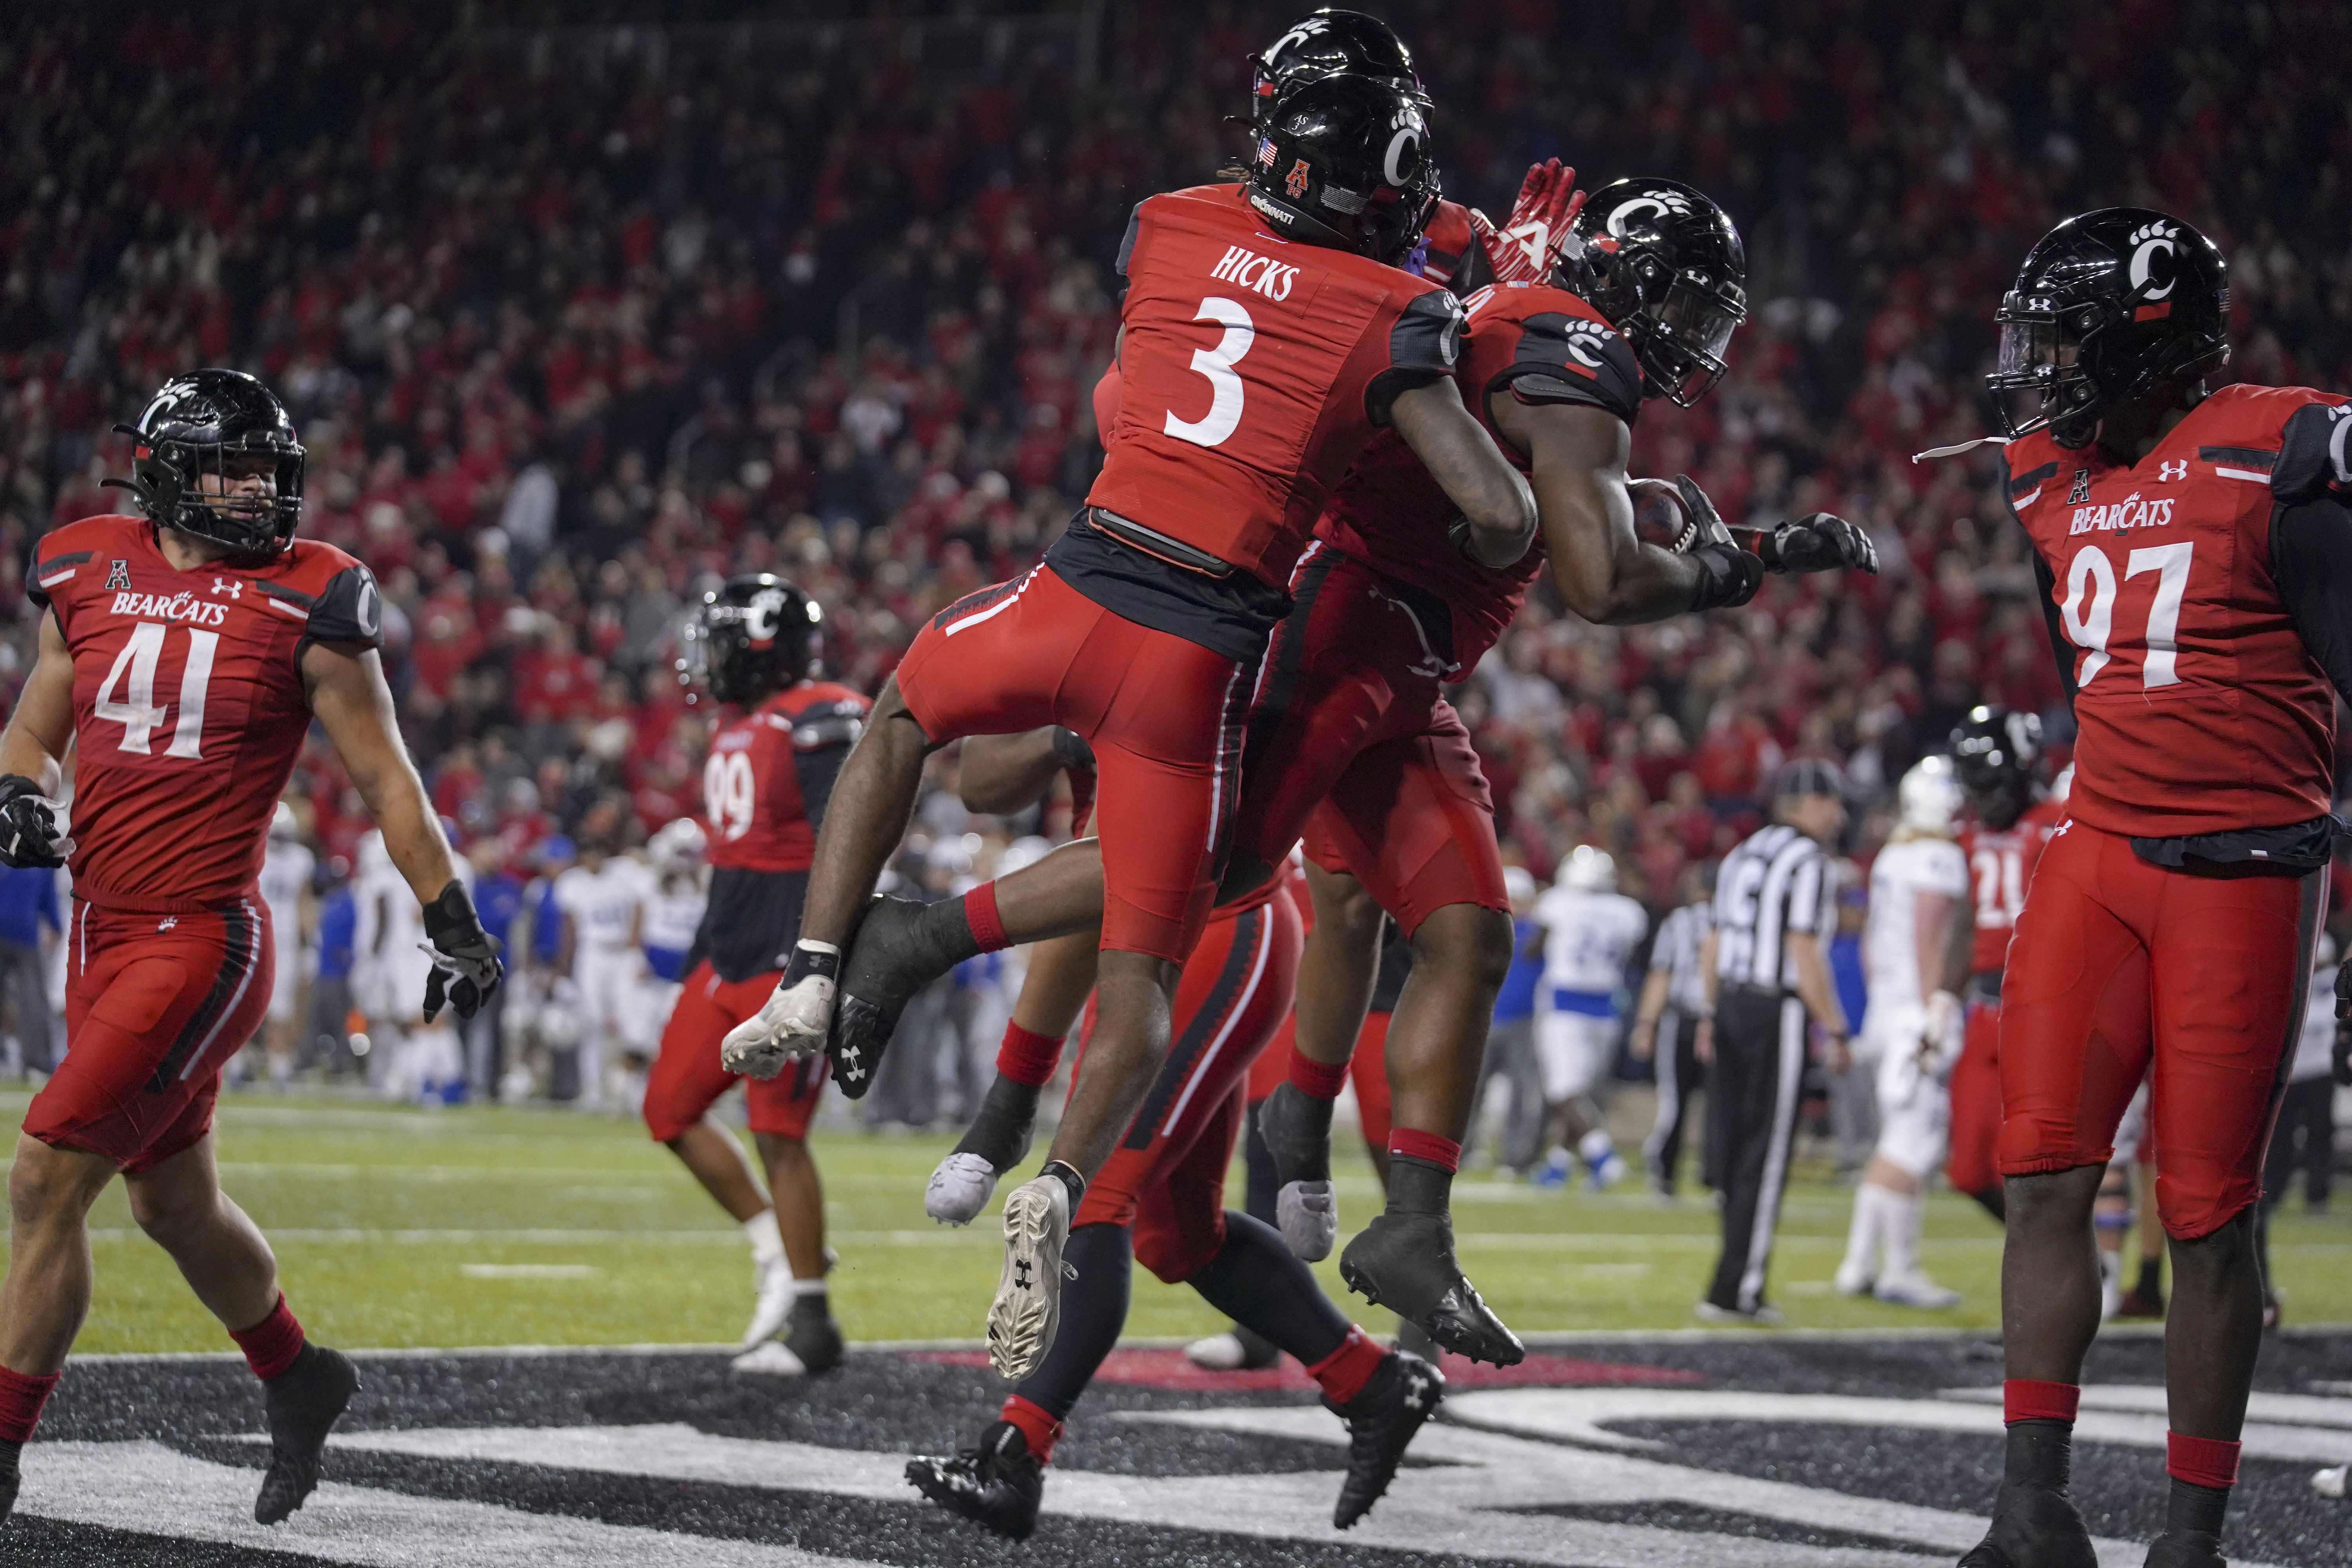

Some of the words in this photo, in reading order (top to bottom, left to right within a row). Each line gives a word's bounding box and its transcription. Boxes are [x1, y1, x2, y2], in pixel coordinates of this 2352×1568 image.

[1294, 114, 1309, 125] AS
[1285, 159, 1310, 191] A
[1286, 184, 1302, 199] P6
[1339, 187, 1357, 196] WARNING
[1250, 194, 1295, 225] CINCINNATI
[1210, 245, 1301, 302] HICKS
[2129, 238, 2176, 300] C
[1163, 297, 1255, 447] 3
[2067, 469, 2090, 505] A
[2069, 491, 2175, 535] BEARCATS
[105, 559, 132, 590] A
[110, 591, 229, 626] BEARCATS
[2061, 541, 2194, 688] 97
[94, 621, 220, 760] 41
[704, 751, 755, 842] 99
[1971, 849, 2025, 929] 21
